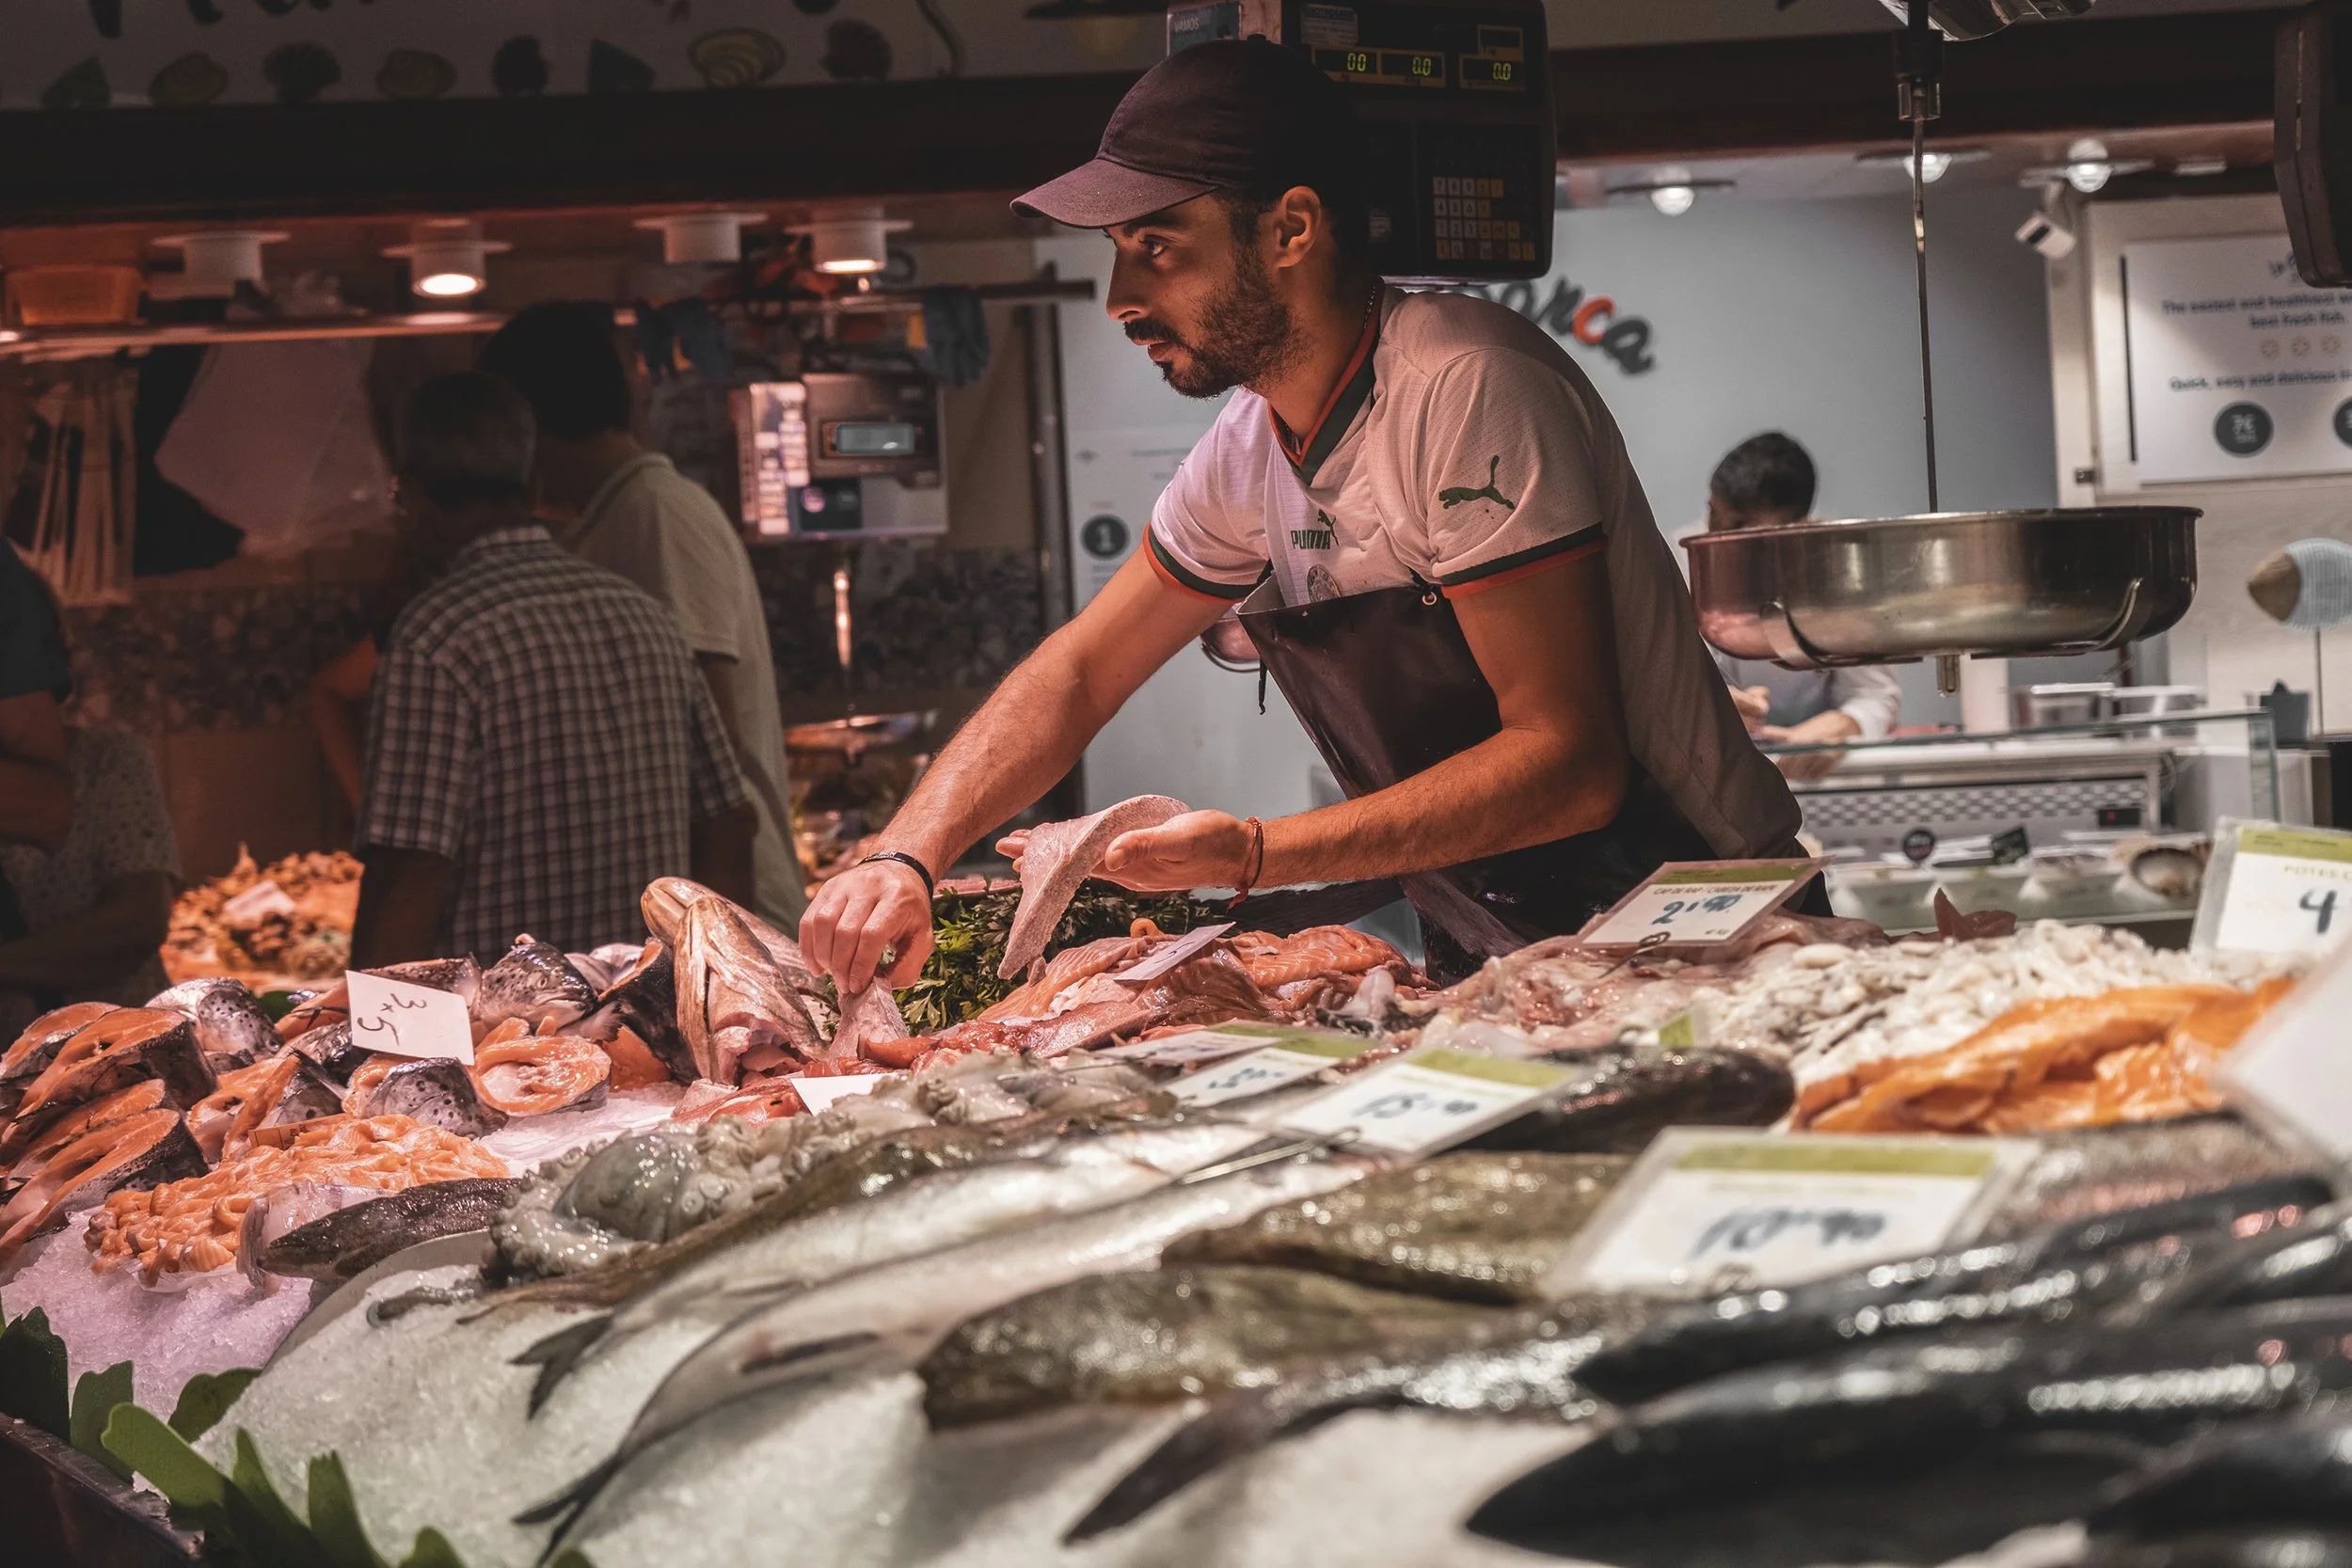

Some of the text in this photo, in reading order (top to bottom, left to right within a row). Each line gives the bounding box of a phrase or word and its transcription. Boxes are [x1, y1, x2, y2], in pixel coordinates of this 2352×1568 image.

[1174, 17, 1200, 32] VAMOS
[2162, 299, 2185, 314] The
[2239, 295, 2265, 310] and
[2249, 372, 2274, 387] and
[1290, 530, 1331, 550] PUMA
